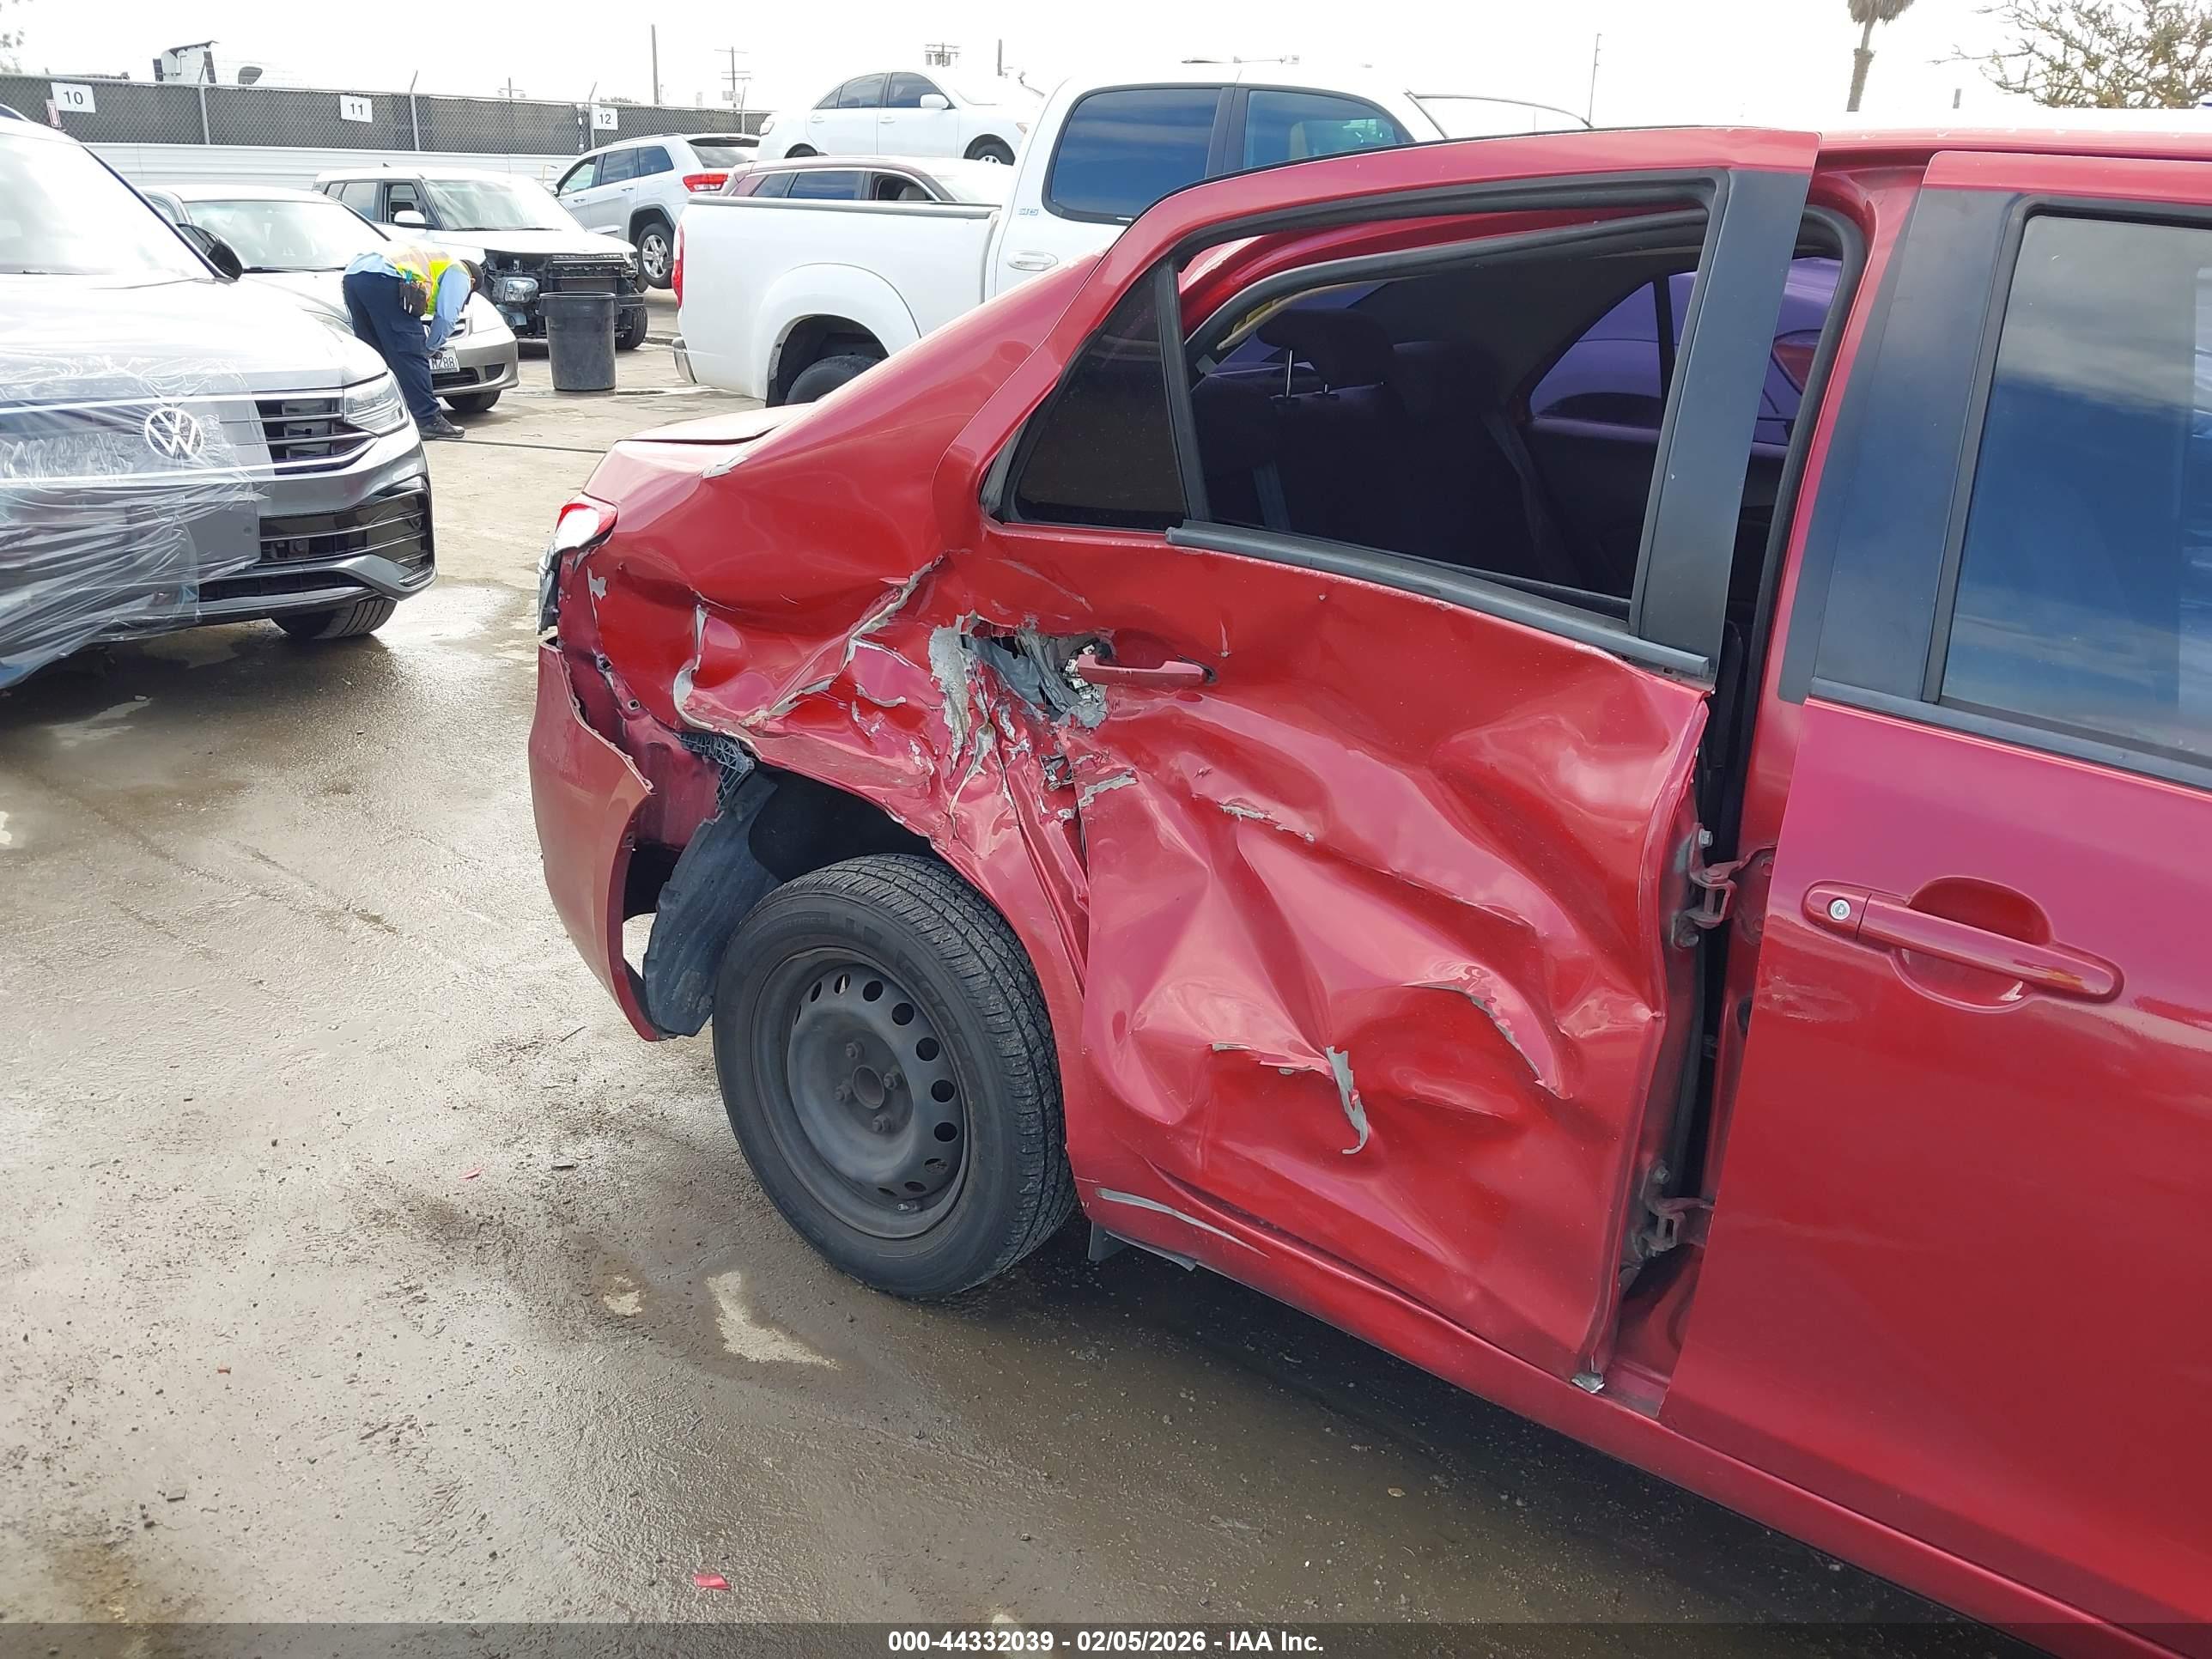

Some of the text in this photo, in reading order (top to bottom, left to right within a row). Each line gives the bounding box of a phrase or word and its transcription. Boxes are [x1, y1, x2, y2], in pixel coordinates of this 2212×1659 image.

[64, 90, 83, 105] 10
[349, 102, 363, 116] 11
[599, 113, 611, 125] 12
